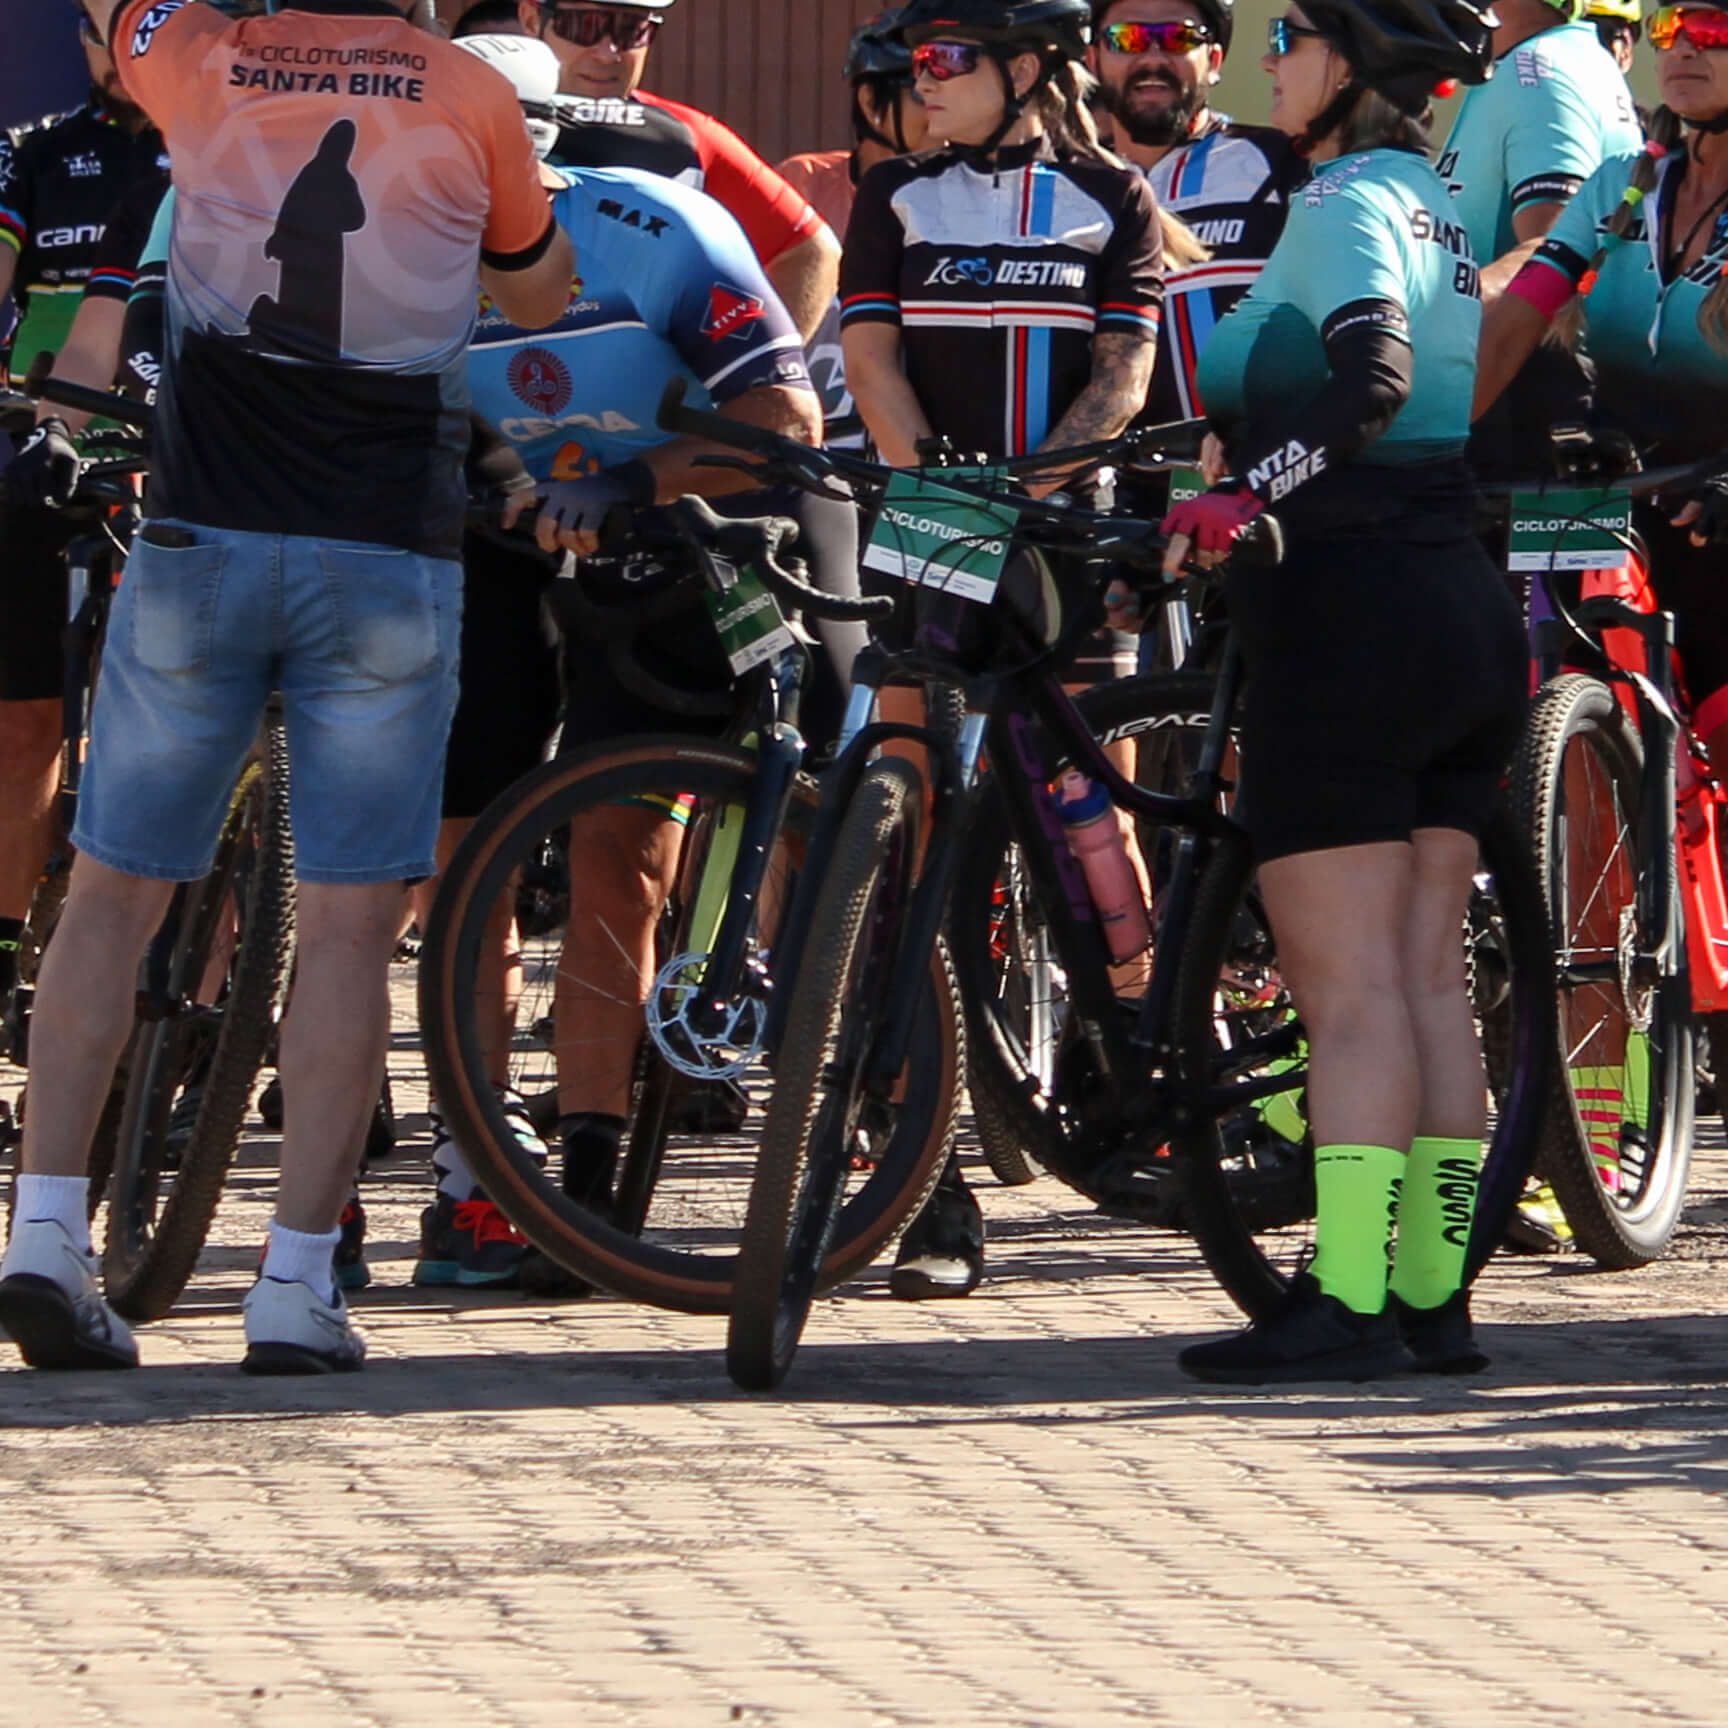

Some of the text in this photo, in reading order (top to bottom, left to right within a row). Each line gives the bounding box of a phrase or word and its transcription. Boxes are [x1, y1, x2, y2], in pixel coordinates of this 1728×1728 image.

[259, 44, 428, 72] CICLOTURISMO
[229, 63, 425, 102] SANTA BIKE
[597, 198, 671, 239] MAX
[995, 258, 1086, 289] DESTINO
[1270, 446, 1327, 503] BIKE
